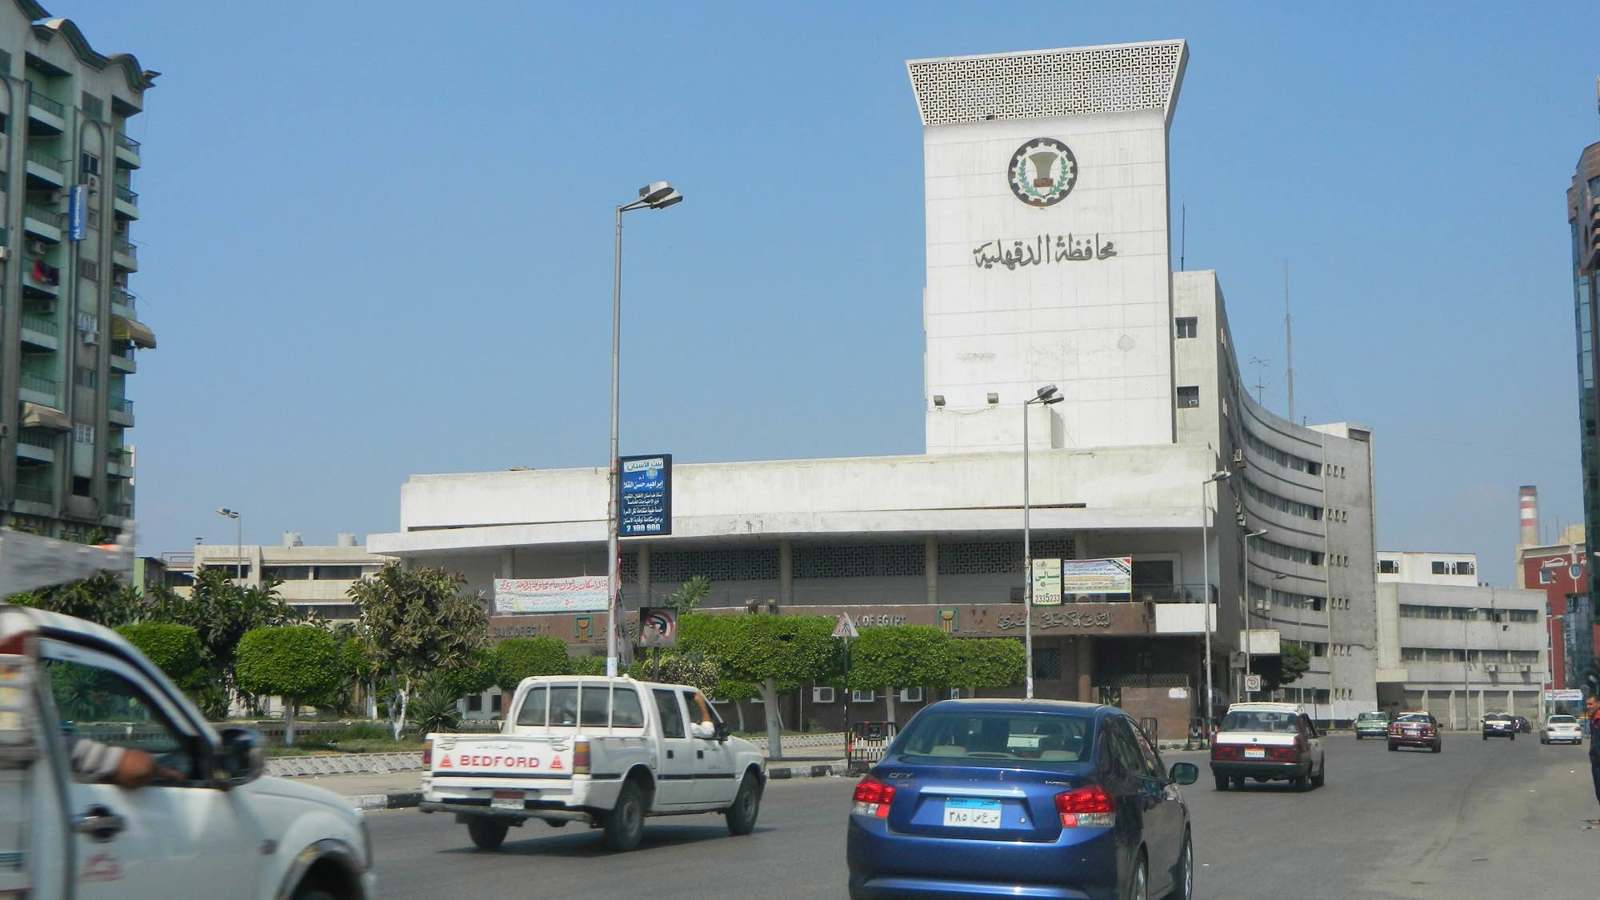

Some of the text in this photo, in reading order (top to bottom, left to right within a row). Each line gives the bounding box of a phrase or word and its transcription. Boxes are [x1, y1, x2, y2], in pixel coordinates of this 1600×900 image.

[973, 232, 1118, 270] محافظة الدقهلية
[460, 755, 540, 768] BEDFORD
